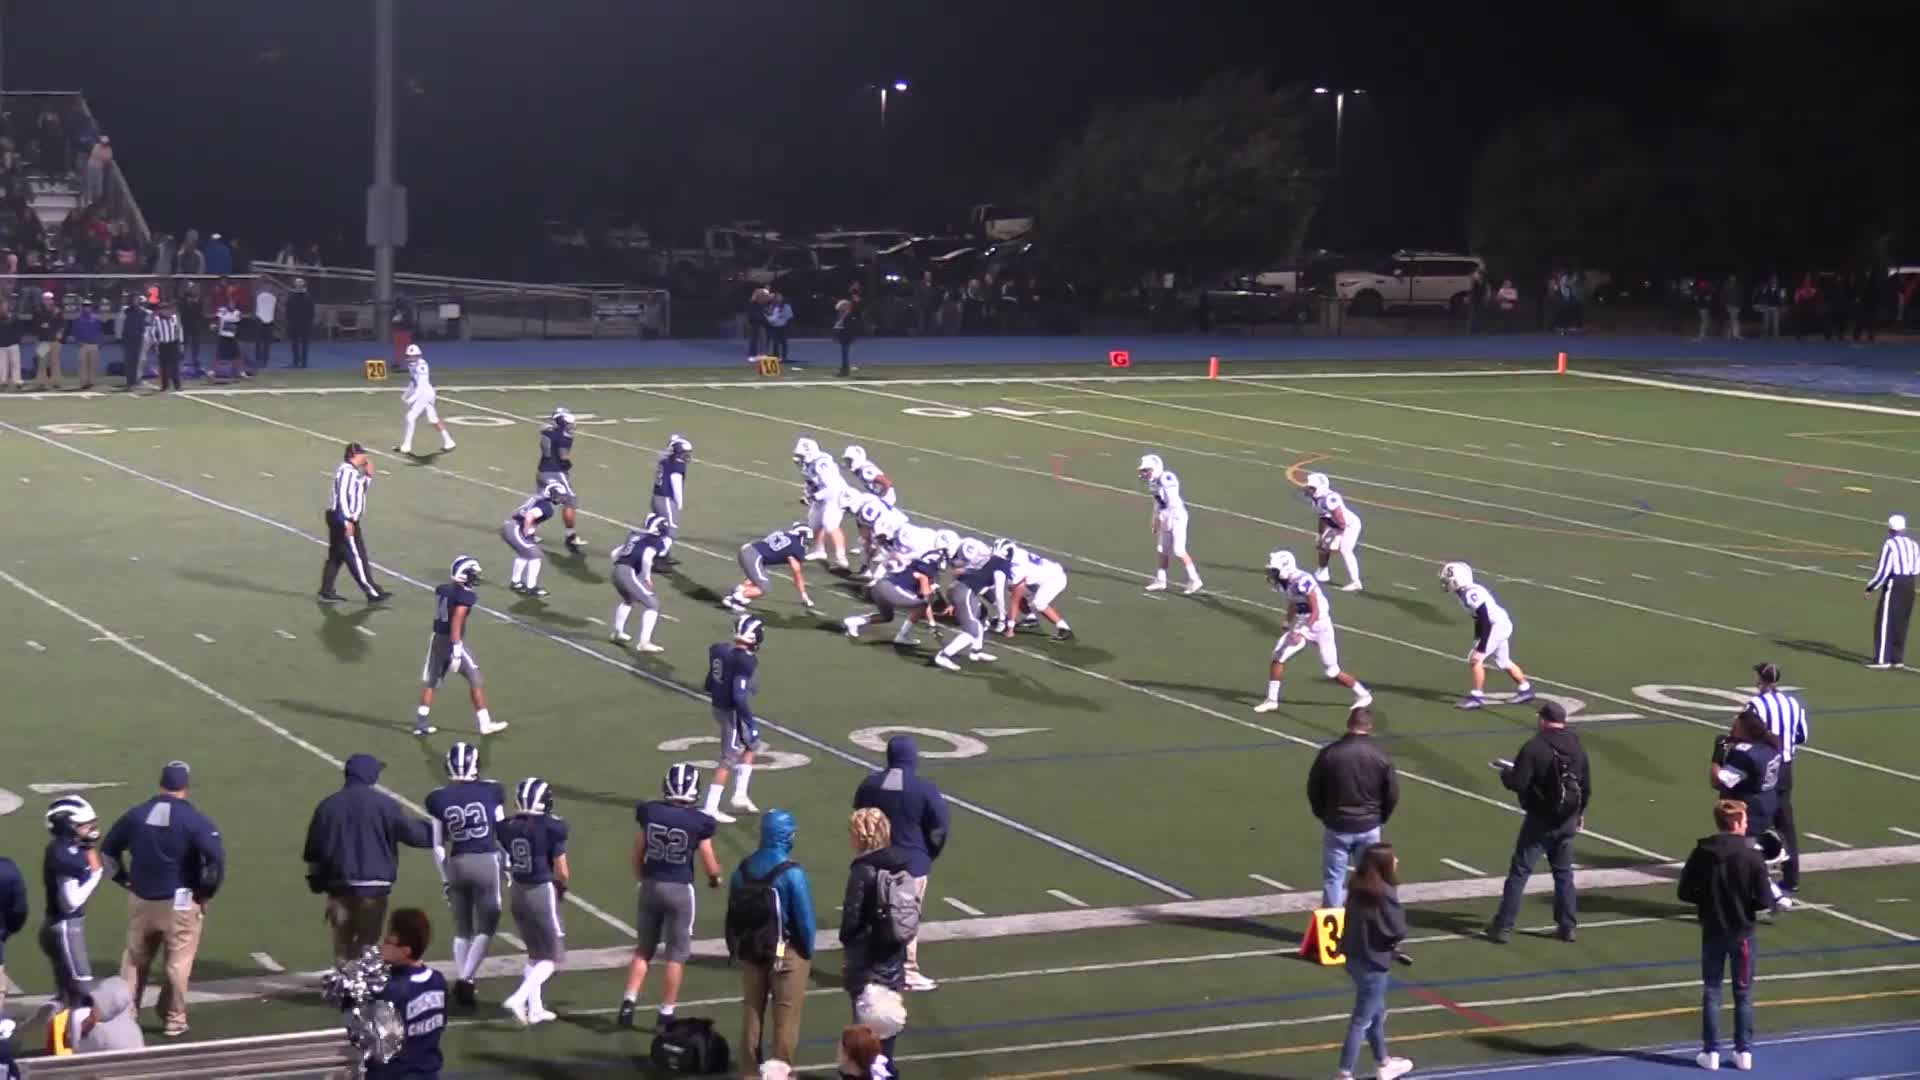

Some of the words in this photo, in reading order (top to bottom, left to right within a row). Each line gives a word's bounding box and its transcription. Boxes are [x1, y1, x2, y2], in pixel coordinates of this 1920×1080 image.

[369, 362, 385, 377] 20
[1113, 353, 1127, 365] G
[657, 726, 988, 771] 30
[444, 801, 489, 840] 23
[511, 838, 533, 873] 9
[645, 823, 688, 864] 52
[1323, 914, 1346, 961] 3
